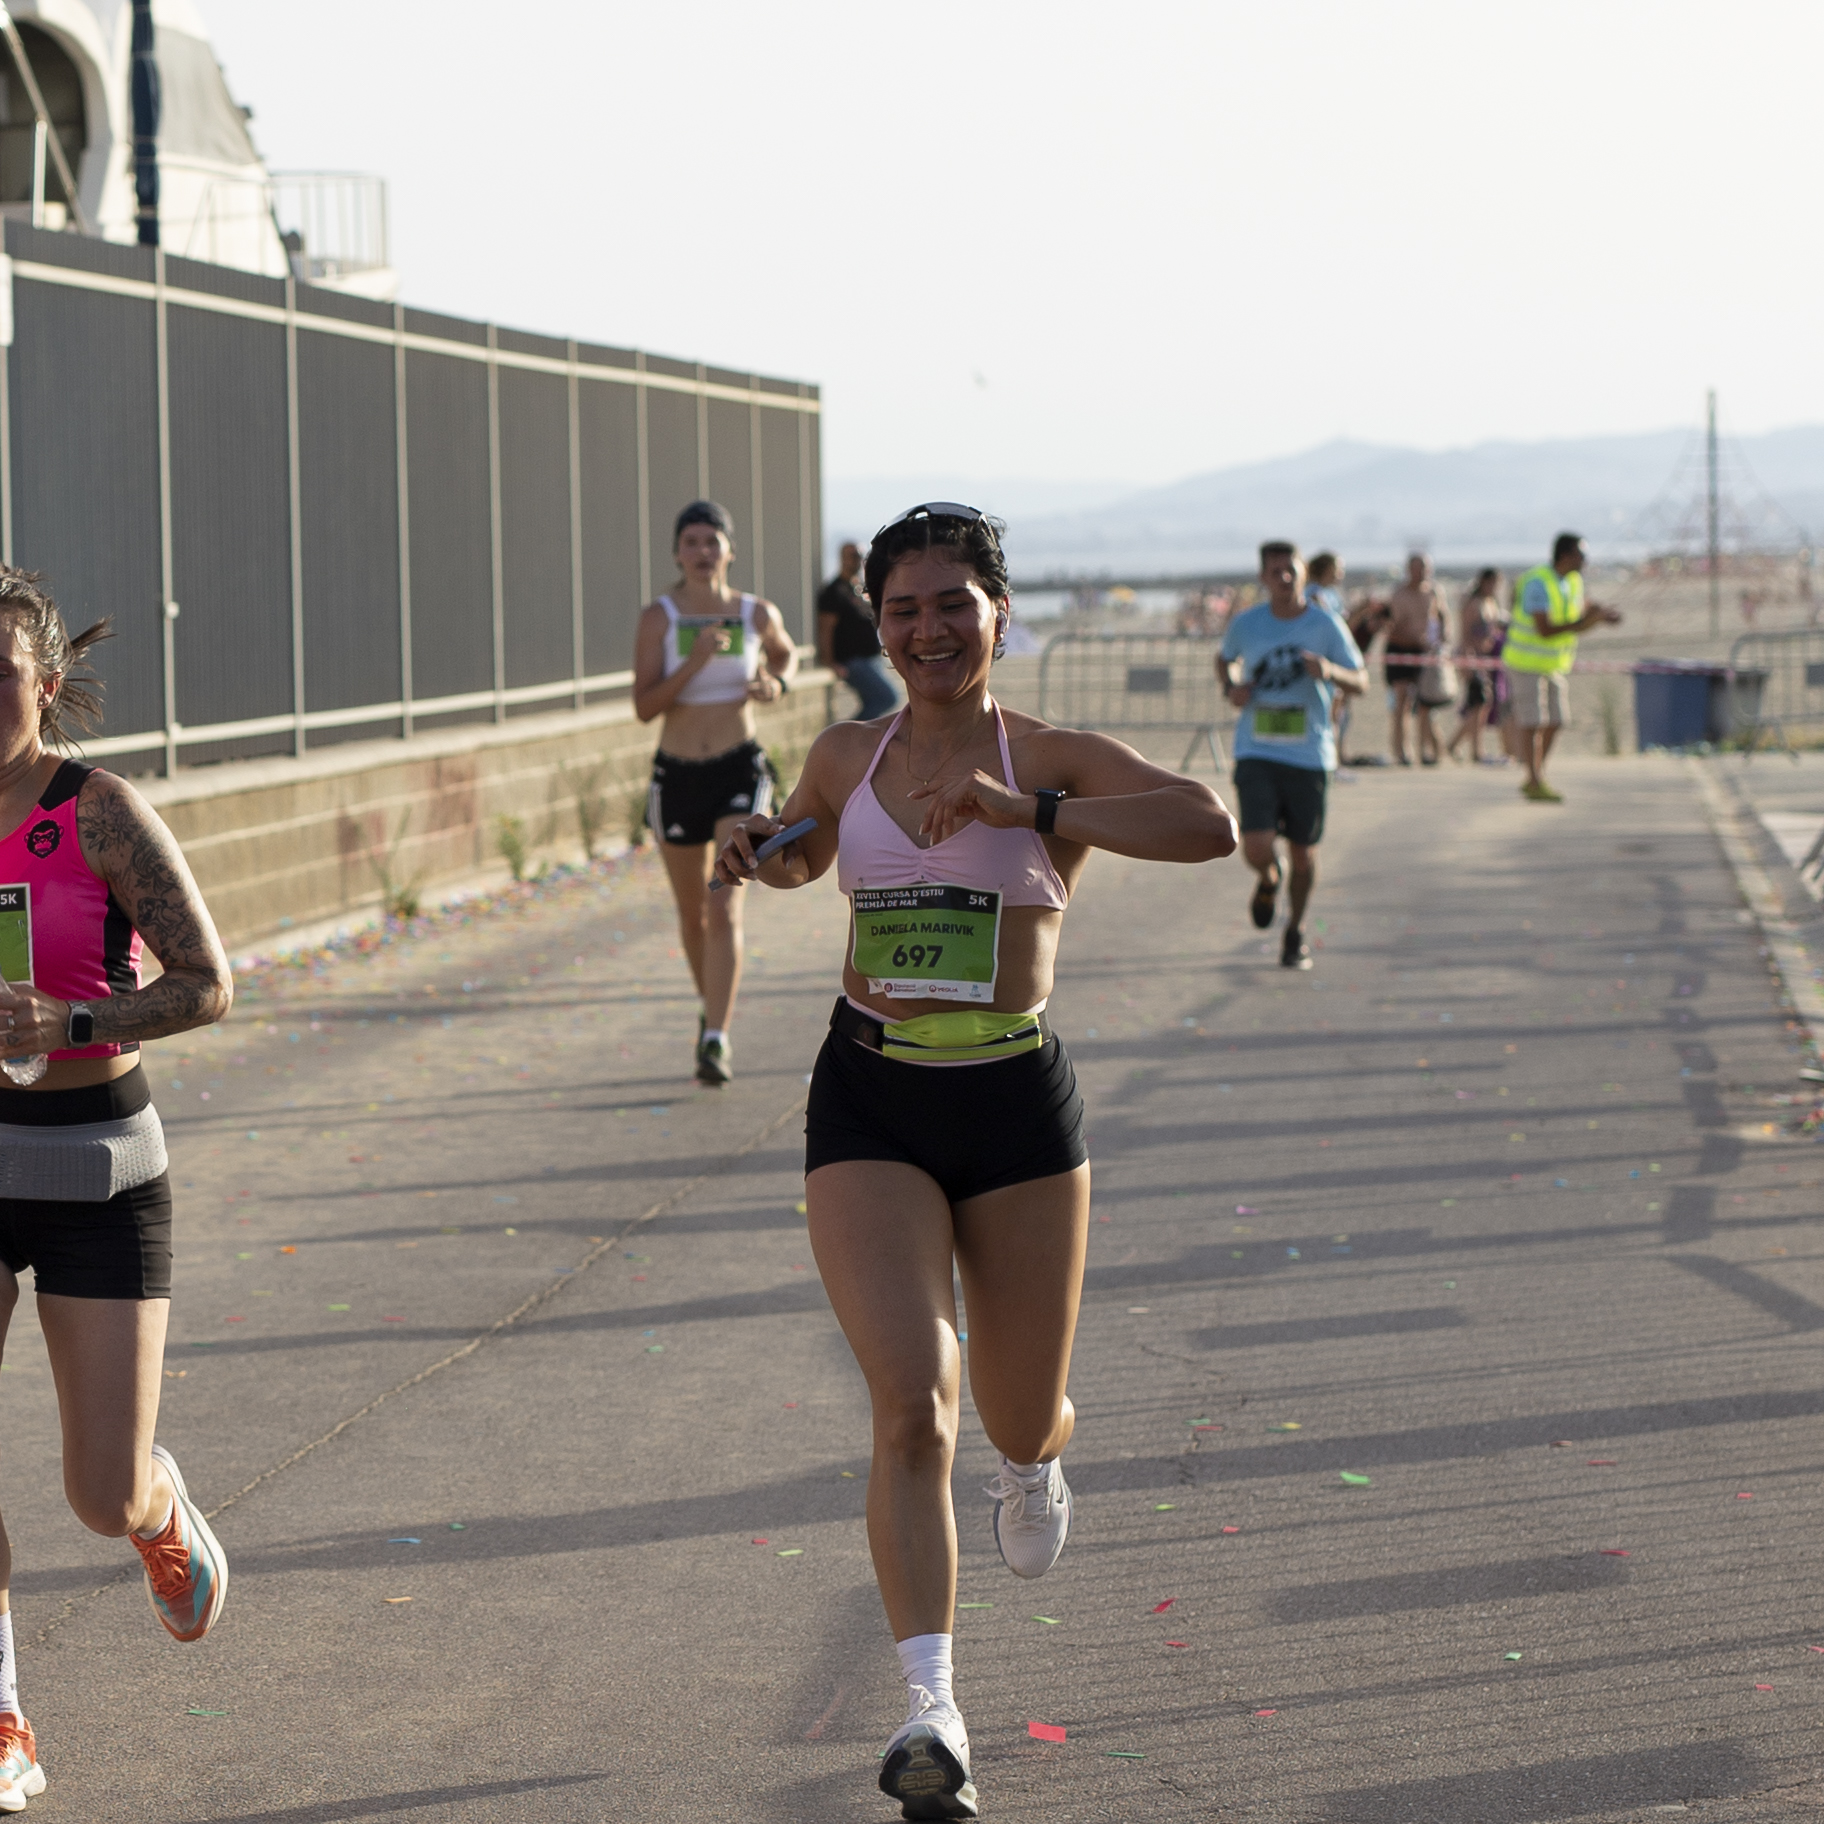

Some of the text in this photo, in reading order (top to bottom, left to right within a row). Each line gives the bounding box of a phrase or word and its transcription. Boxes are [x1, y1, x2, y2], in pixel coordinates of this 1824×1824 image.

[0, 892, 18, 906] 5K
[856, 898, 918, 909] PREMIÀ DE MAR
[882, 890, 911, 899] CURSA
[912, 888, 944, 897] D'ESTIU
[968, 894, 988, 906] 5K
[871, 923, 975, 937] DANIELA MARIVIK
[892, 944, 944, 968] 697
